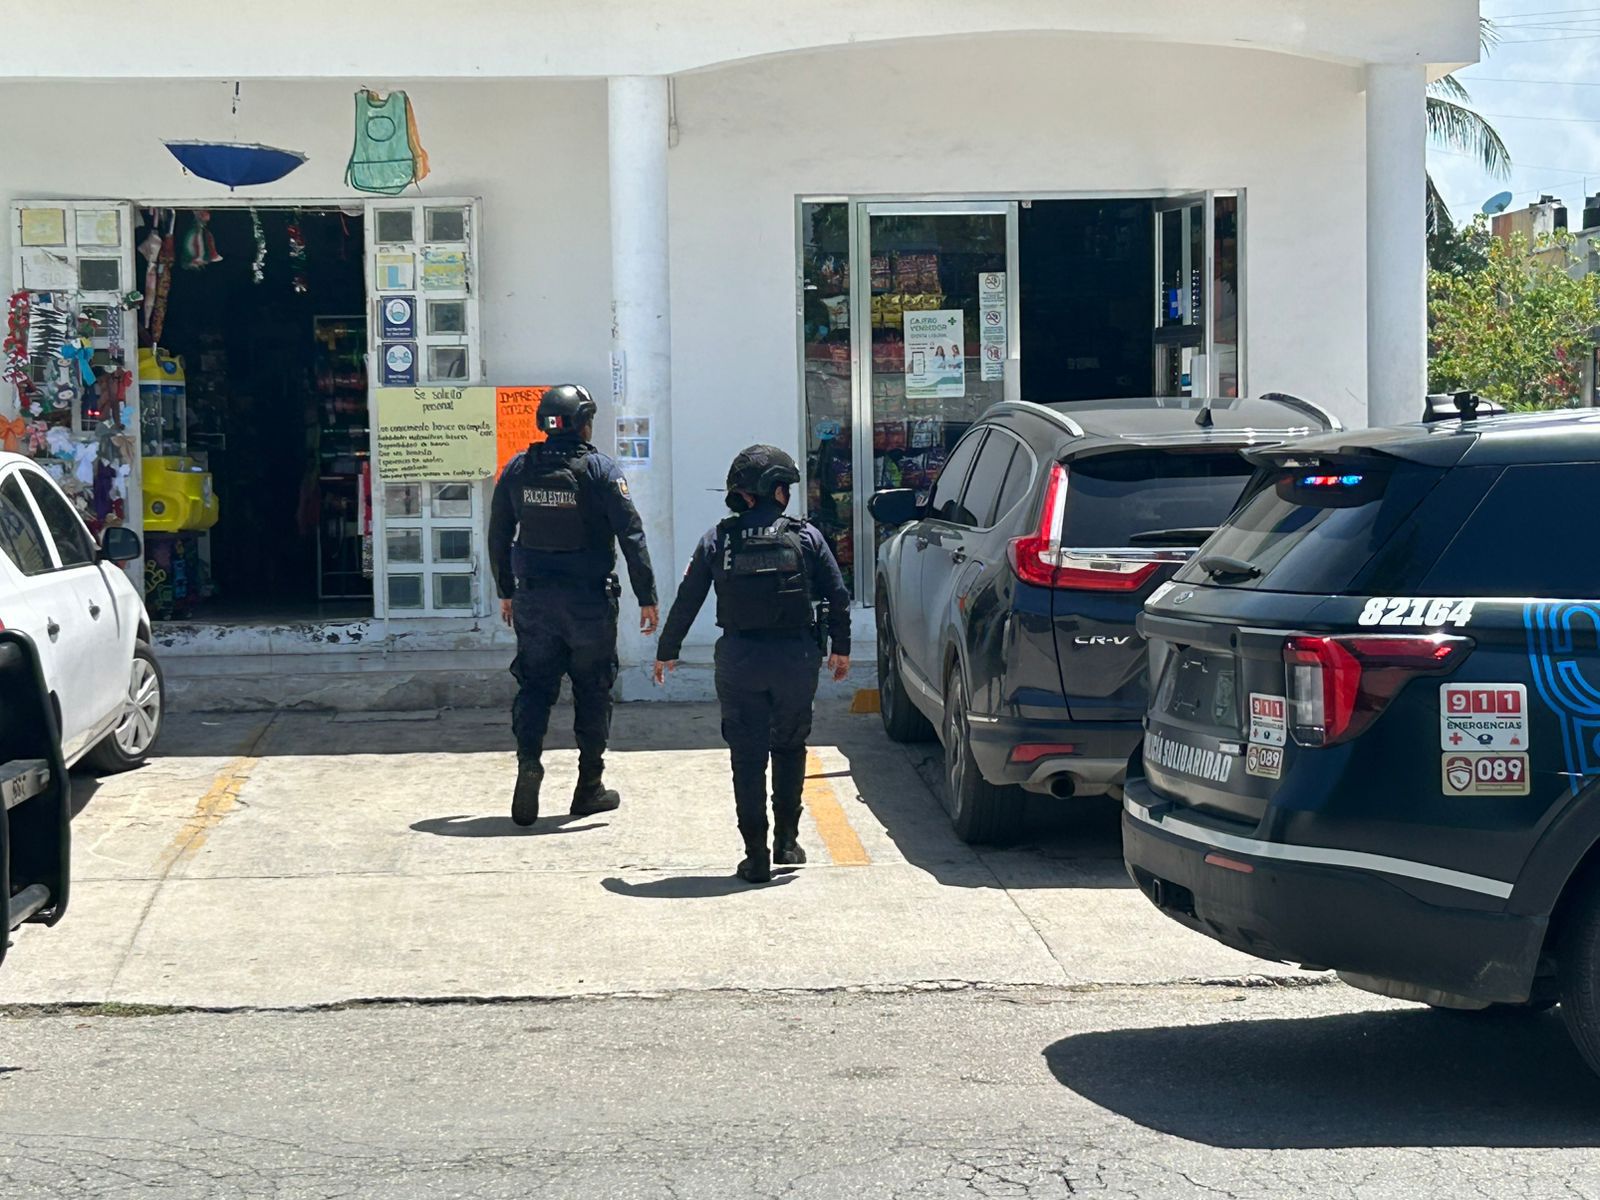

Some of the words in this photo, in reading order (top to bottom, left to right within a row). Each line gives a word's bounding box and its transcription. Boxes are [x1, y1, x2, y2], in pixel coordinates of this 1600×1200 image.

[414, 388, 426, 399] Se
[1358, 596, 1475, 627] 82164
[1074, 635, 1131, 645] CR-V
[1253, 700, 1282, 718] 911
[1451, 693, 1514, 711] 911
[1447, 721, 1522, 730] EMERGENCIAS
[1162, 739, 1233, 783] SOLIDARIDAD
[1259, 749, 1280, 768] 089
[1478, 759, 1522, 781] 089
